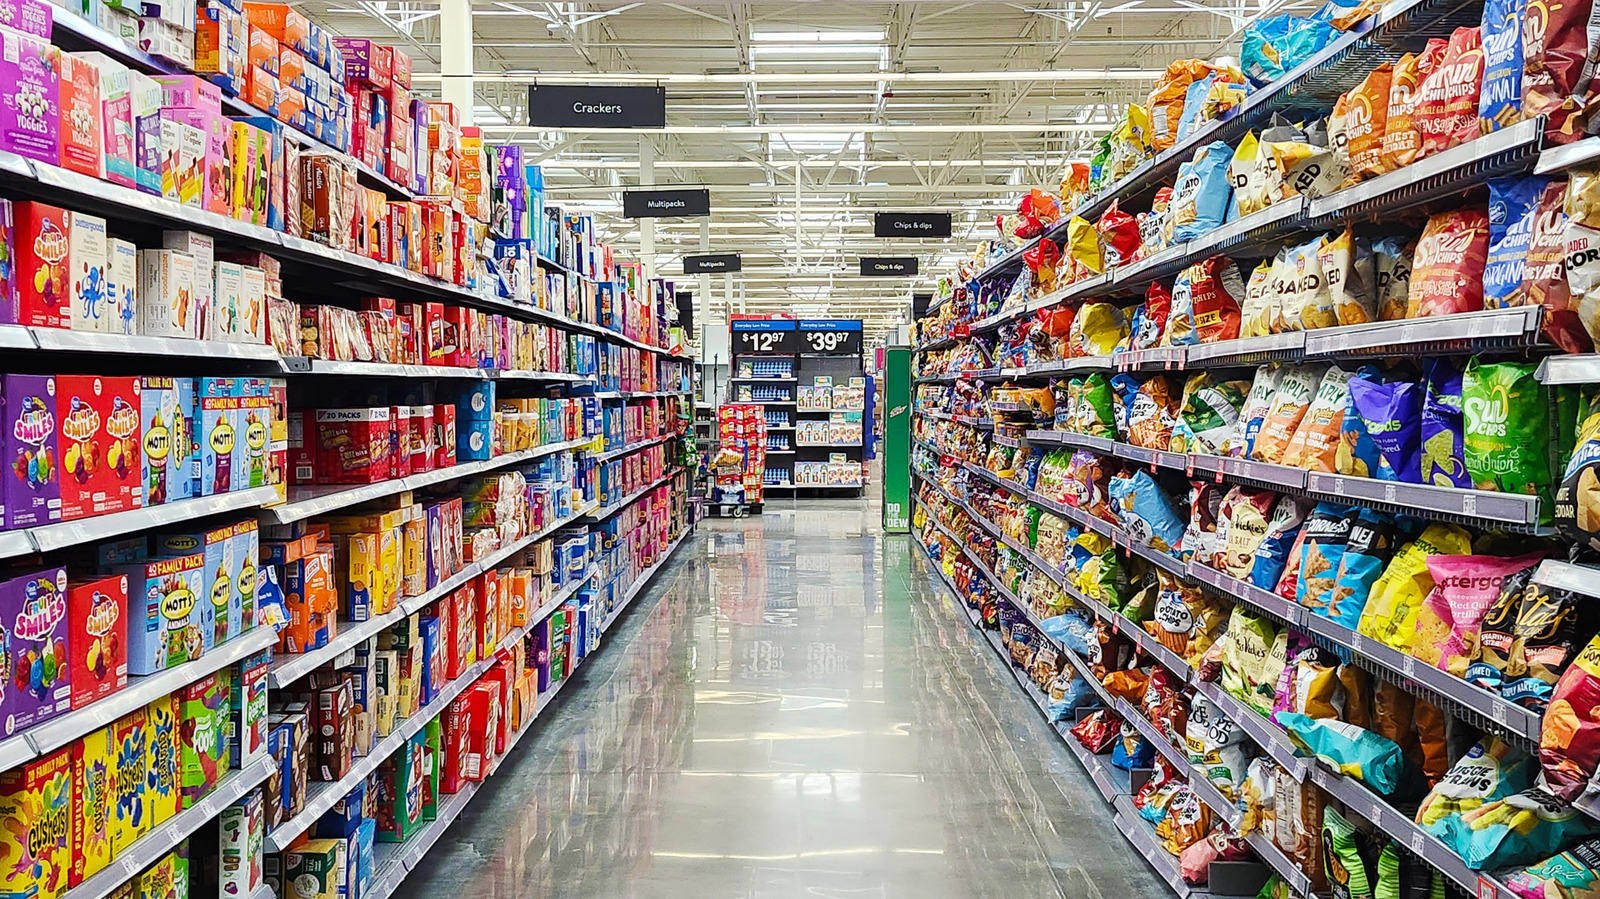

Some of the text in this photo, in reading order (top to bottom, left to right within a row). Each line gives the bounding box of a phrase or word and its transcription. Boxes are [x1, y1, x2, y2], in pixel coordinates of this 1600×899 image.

[1488, 48, 1515, 67] CHIPS
[1425, 87, 1445, 101] CHI
[1447, 83, 1475, 98] CHIPS
[573, 102, 623, 114] Crackers
[1388, 104, 1415, 117] HIPS
[16, 113, 48, 134] YOGGIES
[1295, 163, 1321, 195] KED
[647, 200, 686, 210] Multipacks
[894, 221, 912, 230] Chips
[919, 222, 932, 230] dips
[34, 237, 68, 260] SMILES
[1503, 234, 1531, 248] CHIP
[1539, 235, 1563, 247] CHIP
[1566, 237, 1589, 252] ADED
[1437, 254, 1464, 265] CHIPS
[1566, 248, 1600, 270] COR
[1277, 275, 1320, 295] BAKED
[1200, 313, 1216, 323] SIZE
[148, 378, 161, 388] VALUE
[162, 378, 173, 388] PACK
[1279, 378, 1310, 400] MPLY
[211, 399, 238, 409] FAMILY PACK
[246, 397, 270, 408] FAMILY PACK
[24, 409, 45, 423] FRUIT
[72, 409, 91, 422] FRUIT
[1464, 388, 1509, 435] Sun
[14, 415, 54, 441] SMILES
[63, 414, 100, 439] SMILES
[107, 414, 139, 438] SMILES
[887, 503, 900, 512] DO
[887, 518, 908, 528] DEW
[167, 539, 196, 547] MOTT'S
[1234, 537, 1251, 548] SALT
[157, 559, 183, 574] FAMILY
[185, 555, 204, 569] PACK
[27, 593, 53, 616] FRUIT
[165, 595, 192, 612] MOTT'S
[1450, 600, 1469, 610] Red
[15, 598, 65, 638] SMILES
[87, 603, 119, 635] SMILES
[1160, 606, 1189, 620] POTATO
[168, 615, 190, 630] ANIMALS
[1209, 726, 1229, 744] OD
[36, 761, 55, 779] FAMILY
[56, 753, 69, 769] PACK
[93, 771, 103, 834] Gushers
[28, 808, 67, 861] Gushers
